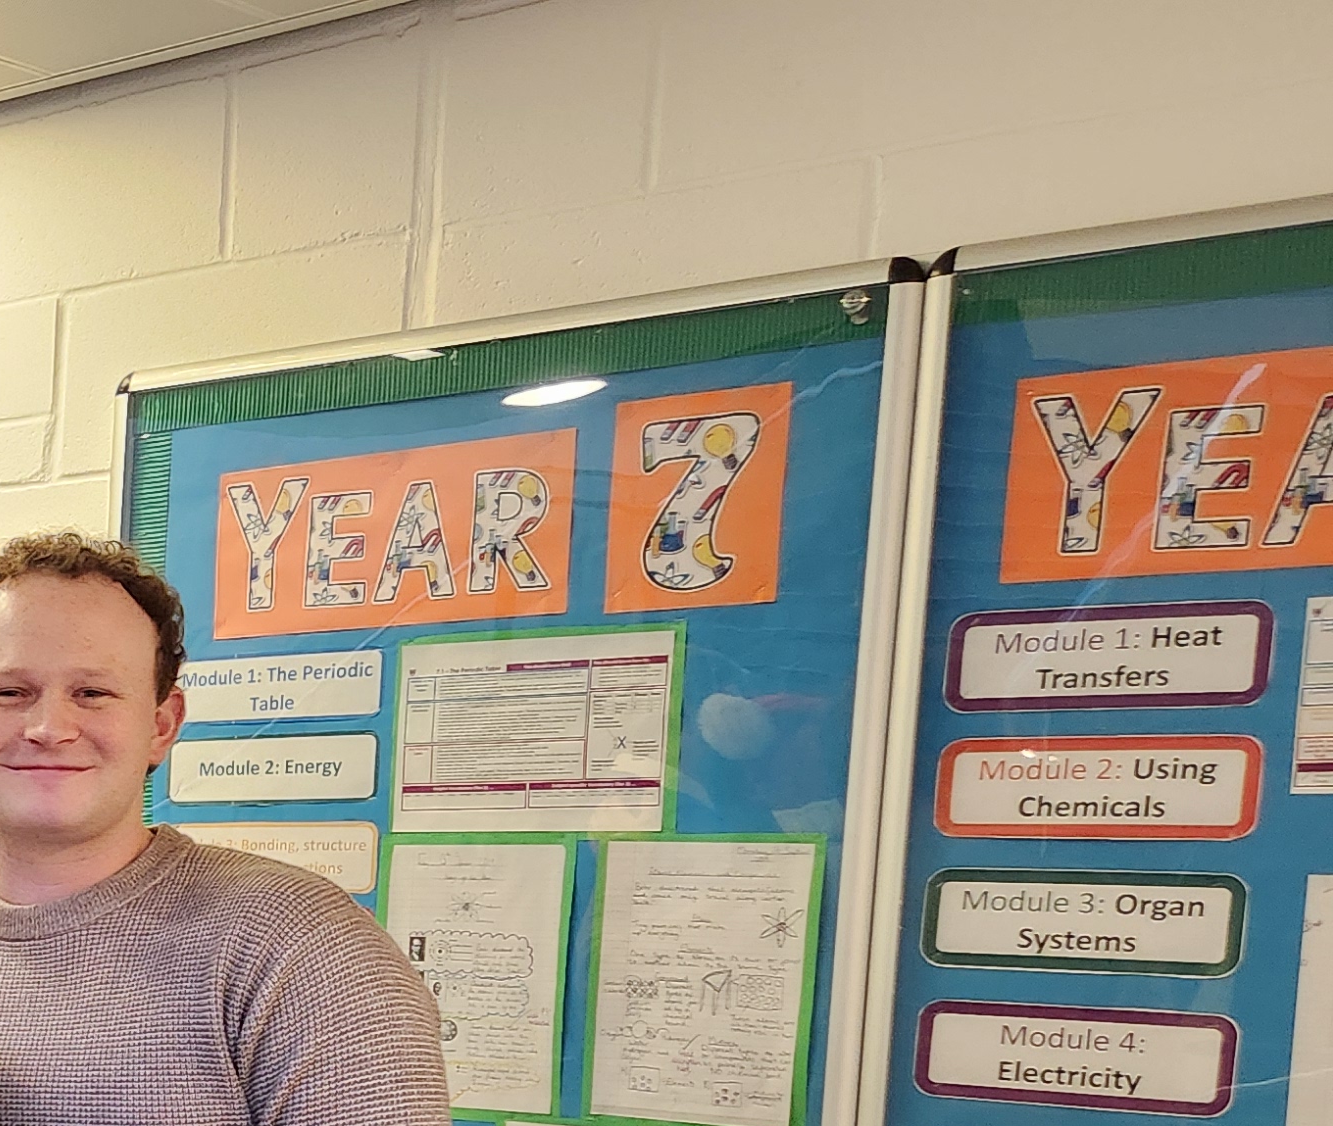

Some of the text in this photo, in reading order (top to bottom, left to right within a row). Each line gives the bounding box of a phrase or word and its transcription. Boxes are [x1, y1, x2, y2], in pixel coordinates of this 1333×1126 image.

[227, 468, 550, 612] YEAR
[995, 625, 1223, 654] Module 1: Heat
[183, 662, 374, 687] Module 1: The Periodic
[1035, 666, 1169, 690] Transfers
[249, 695, 295, 712] Table
[199, 759, 342, 777] Module 2: Energy
[979, 757, 1218, 785] Module 2: Using
[1017, 795, 1166, 819] Chemicals
[241, 839, 299, 853] Bonding,
[303, 840, 367, 852] structure
[962, 889, 1205, 921] Module 3: Organ
[1017, 928, 1137, 956] Systems
[1000, 1024, 1146, 1053] Module 4:
[998, 1060, 1142, 1095] Electricity
